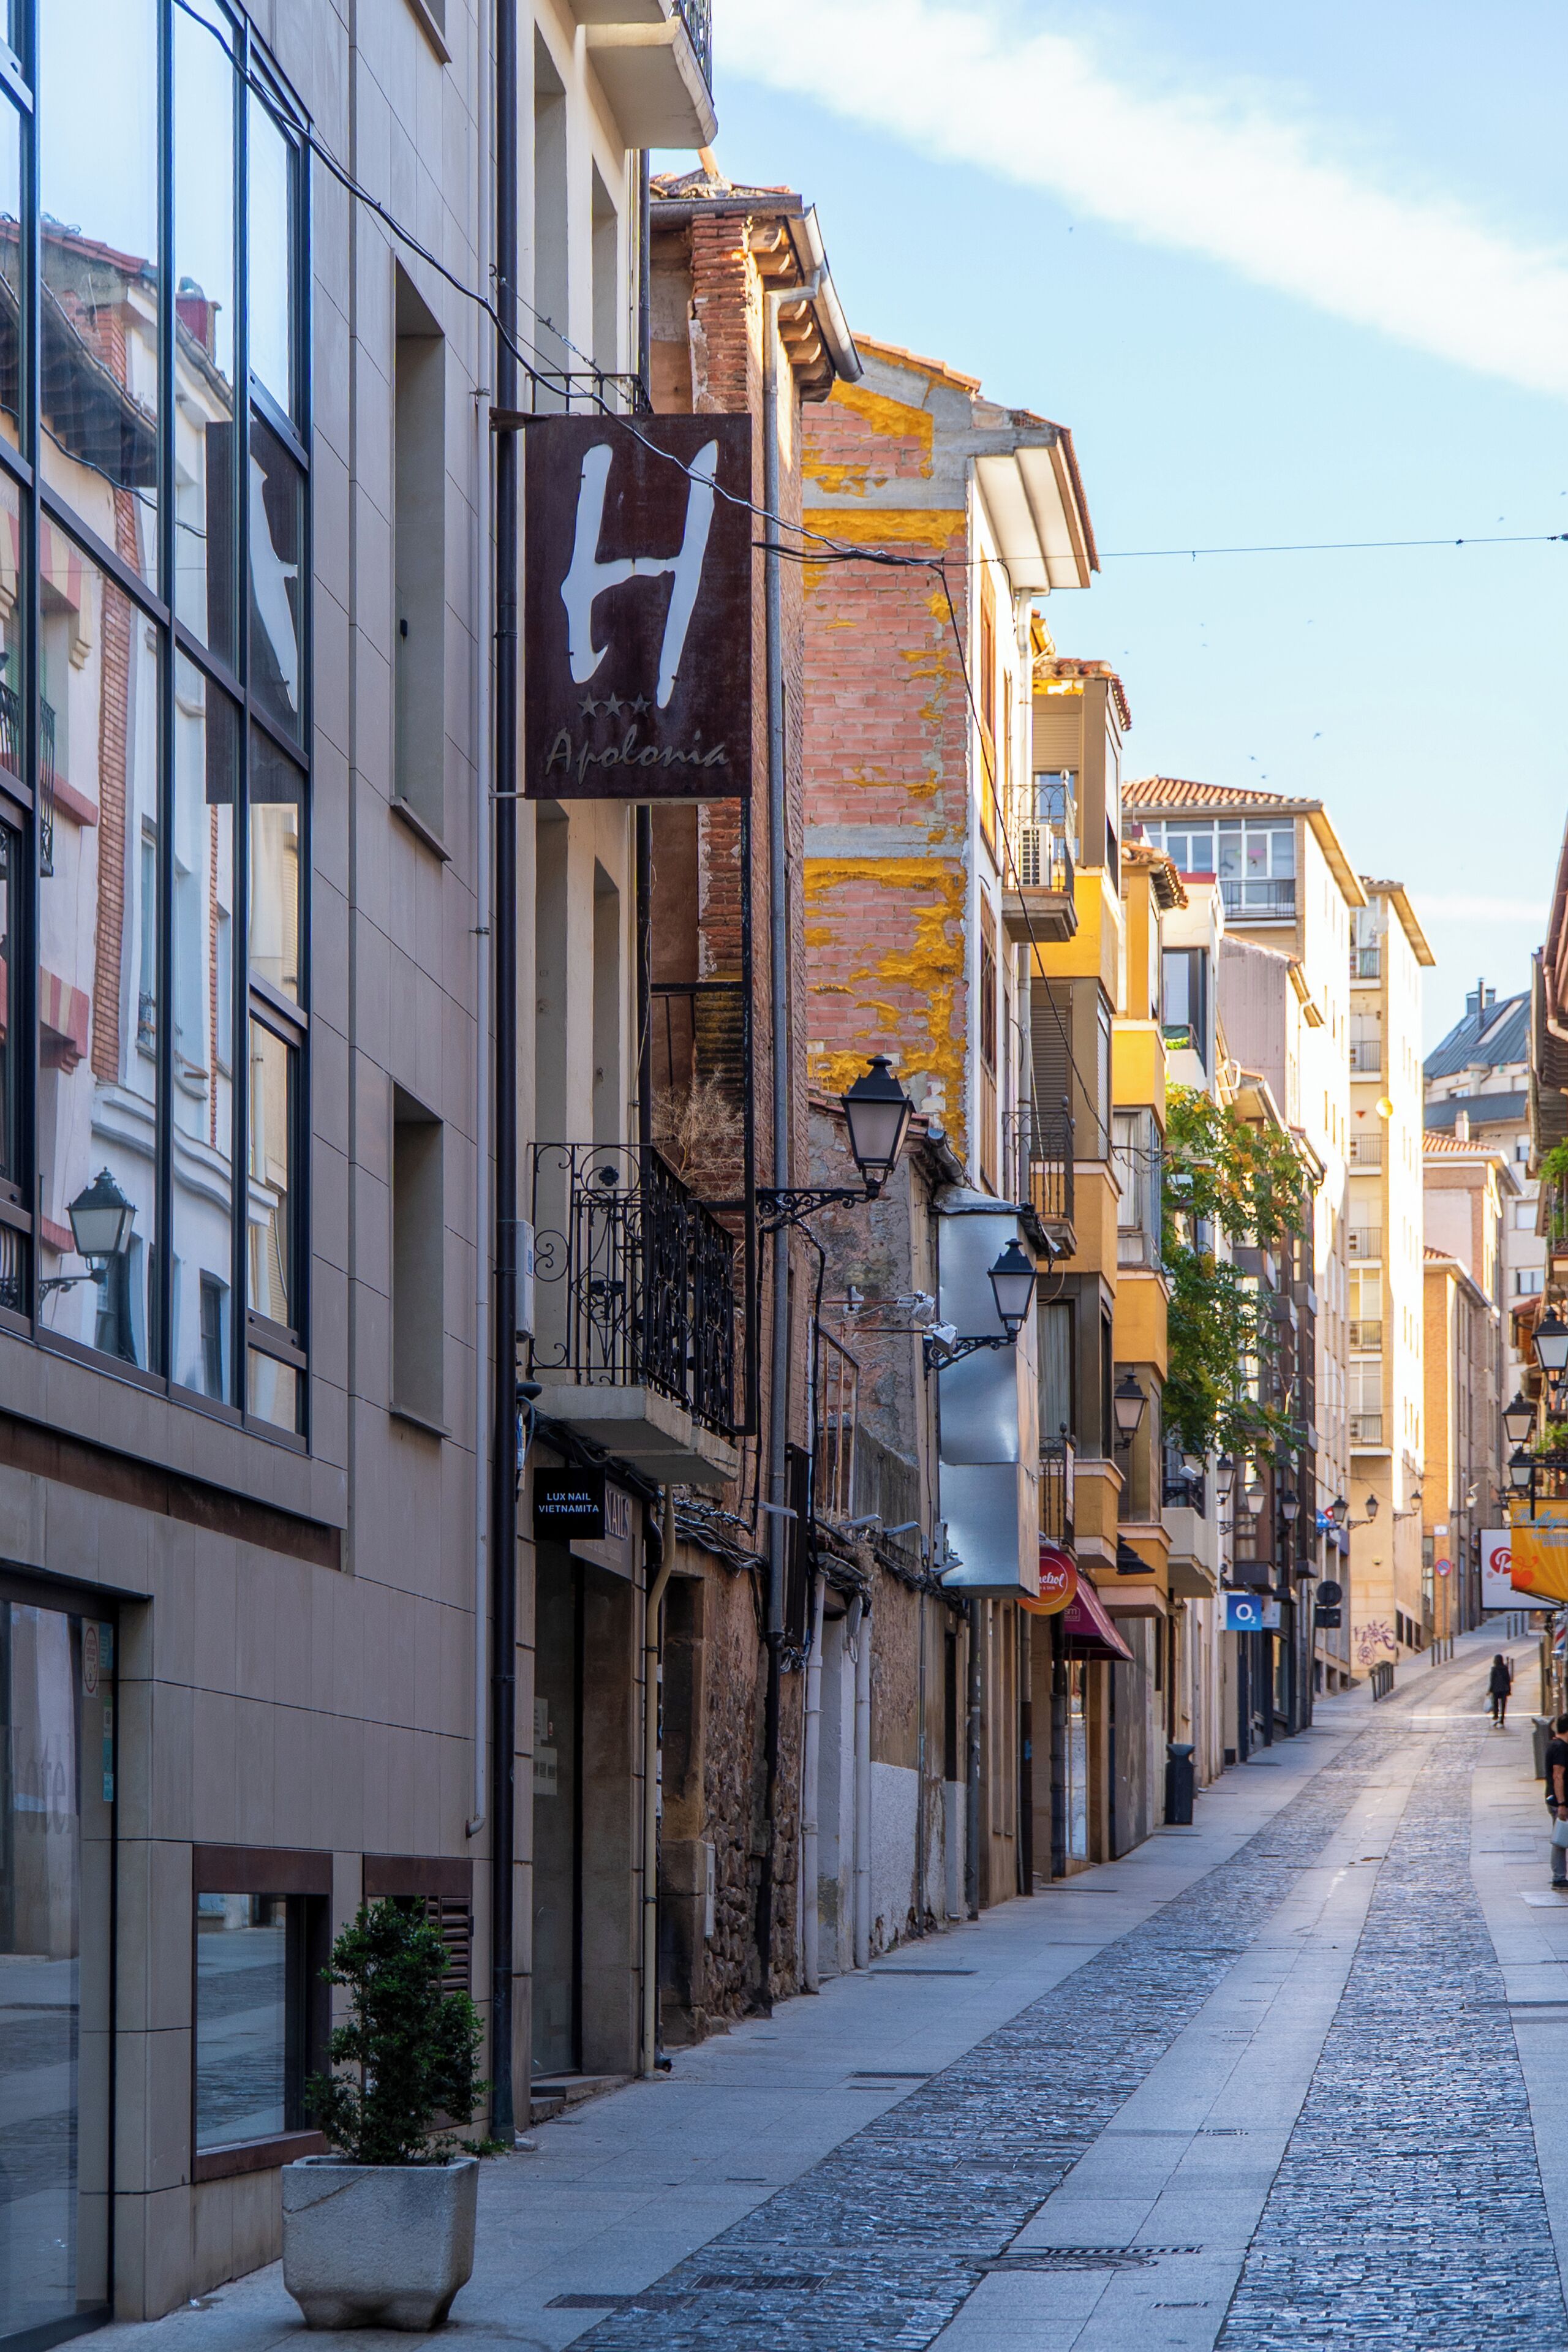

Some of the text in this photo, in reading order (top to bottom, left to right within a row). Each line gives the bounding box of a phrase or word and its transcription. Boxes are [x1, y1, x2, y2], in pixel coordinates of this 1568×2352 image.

[560, 439, 720, 709] H
[544, 724, 729, 785] Apolonia
[538, 1504, 600, 1513] VIETNAMITA
